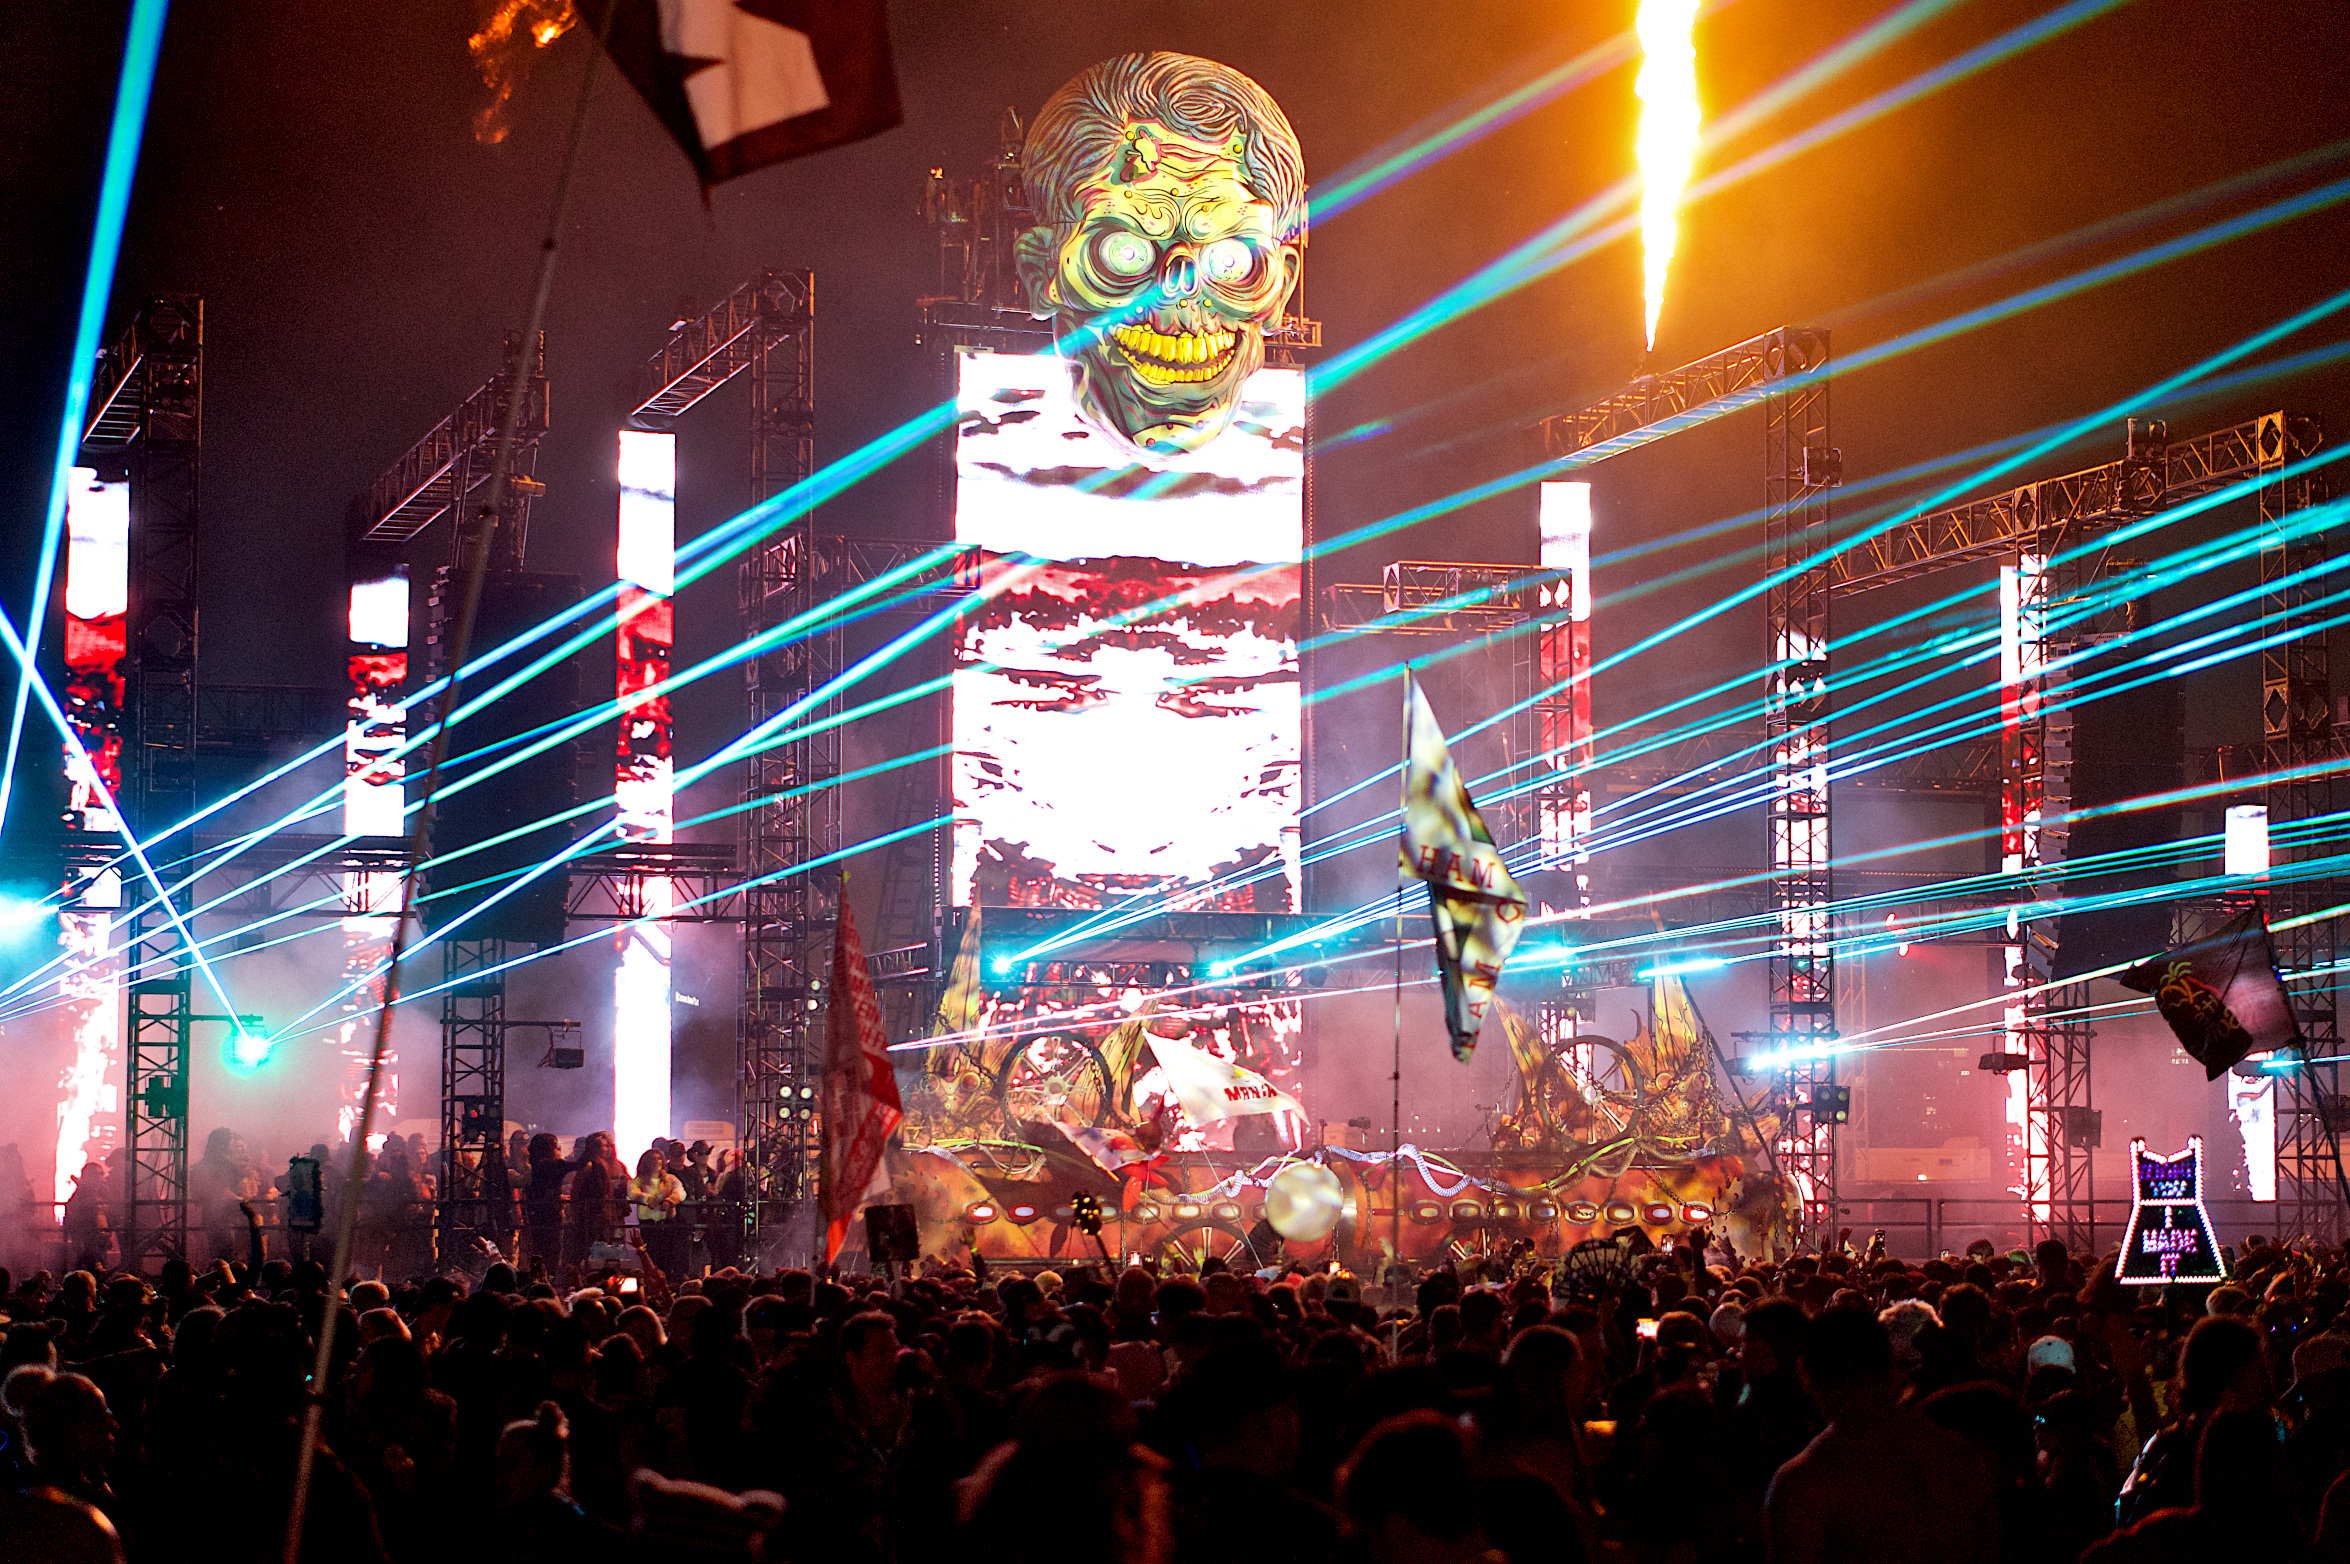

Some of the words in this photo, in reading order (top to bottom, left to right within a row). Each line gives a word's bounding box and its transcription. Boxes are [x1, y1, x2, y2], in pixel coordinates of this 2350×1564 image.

[1416, 845, 1496, 889] HAM
[1224, 1083, 1277, 1101] MANIA
[2164, 1205, 2173, 1229] I
[2142, 1228, 2198, 1254] MADE
[2160, 1253, 2182, 1277] IT
